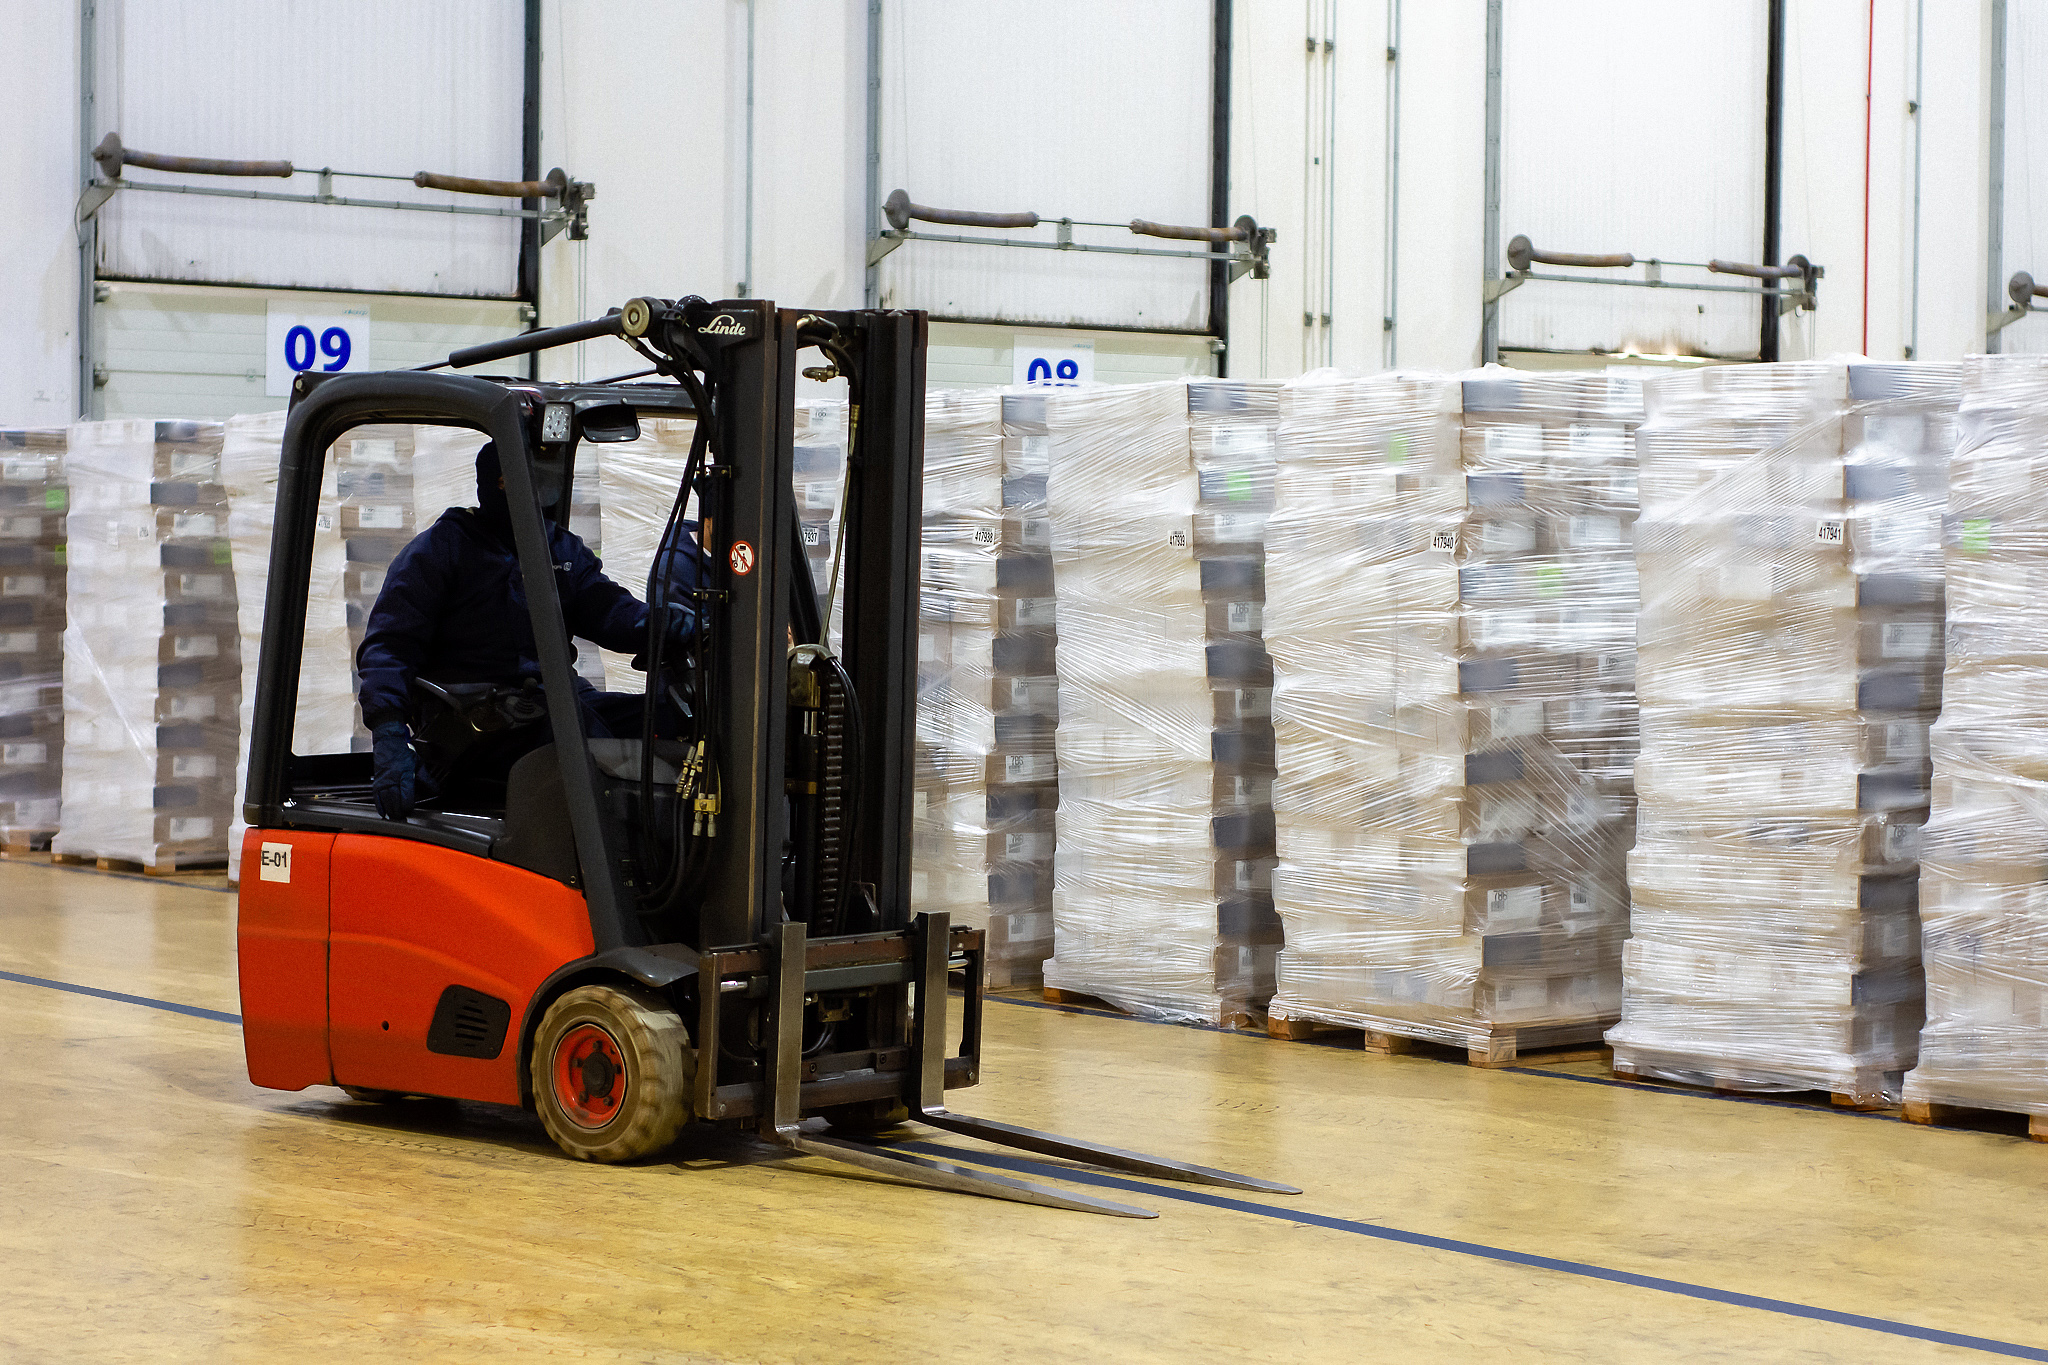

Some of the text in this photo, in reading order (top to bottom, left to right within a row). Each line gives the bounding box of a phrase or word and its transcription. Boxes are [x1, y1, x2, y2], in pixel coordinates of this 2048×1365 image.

[698, 314, 746, 336] Linde
[285, 324, 352, 372] 09
[804, 531, 818, 543] 7937
[974, 531, 994, 543] 417938
[1818, 526, 1842, 541] 417941
[1433, 536, 1454, 550] 417940
[1493, 890, 1508, 902] 786
